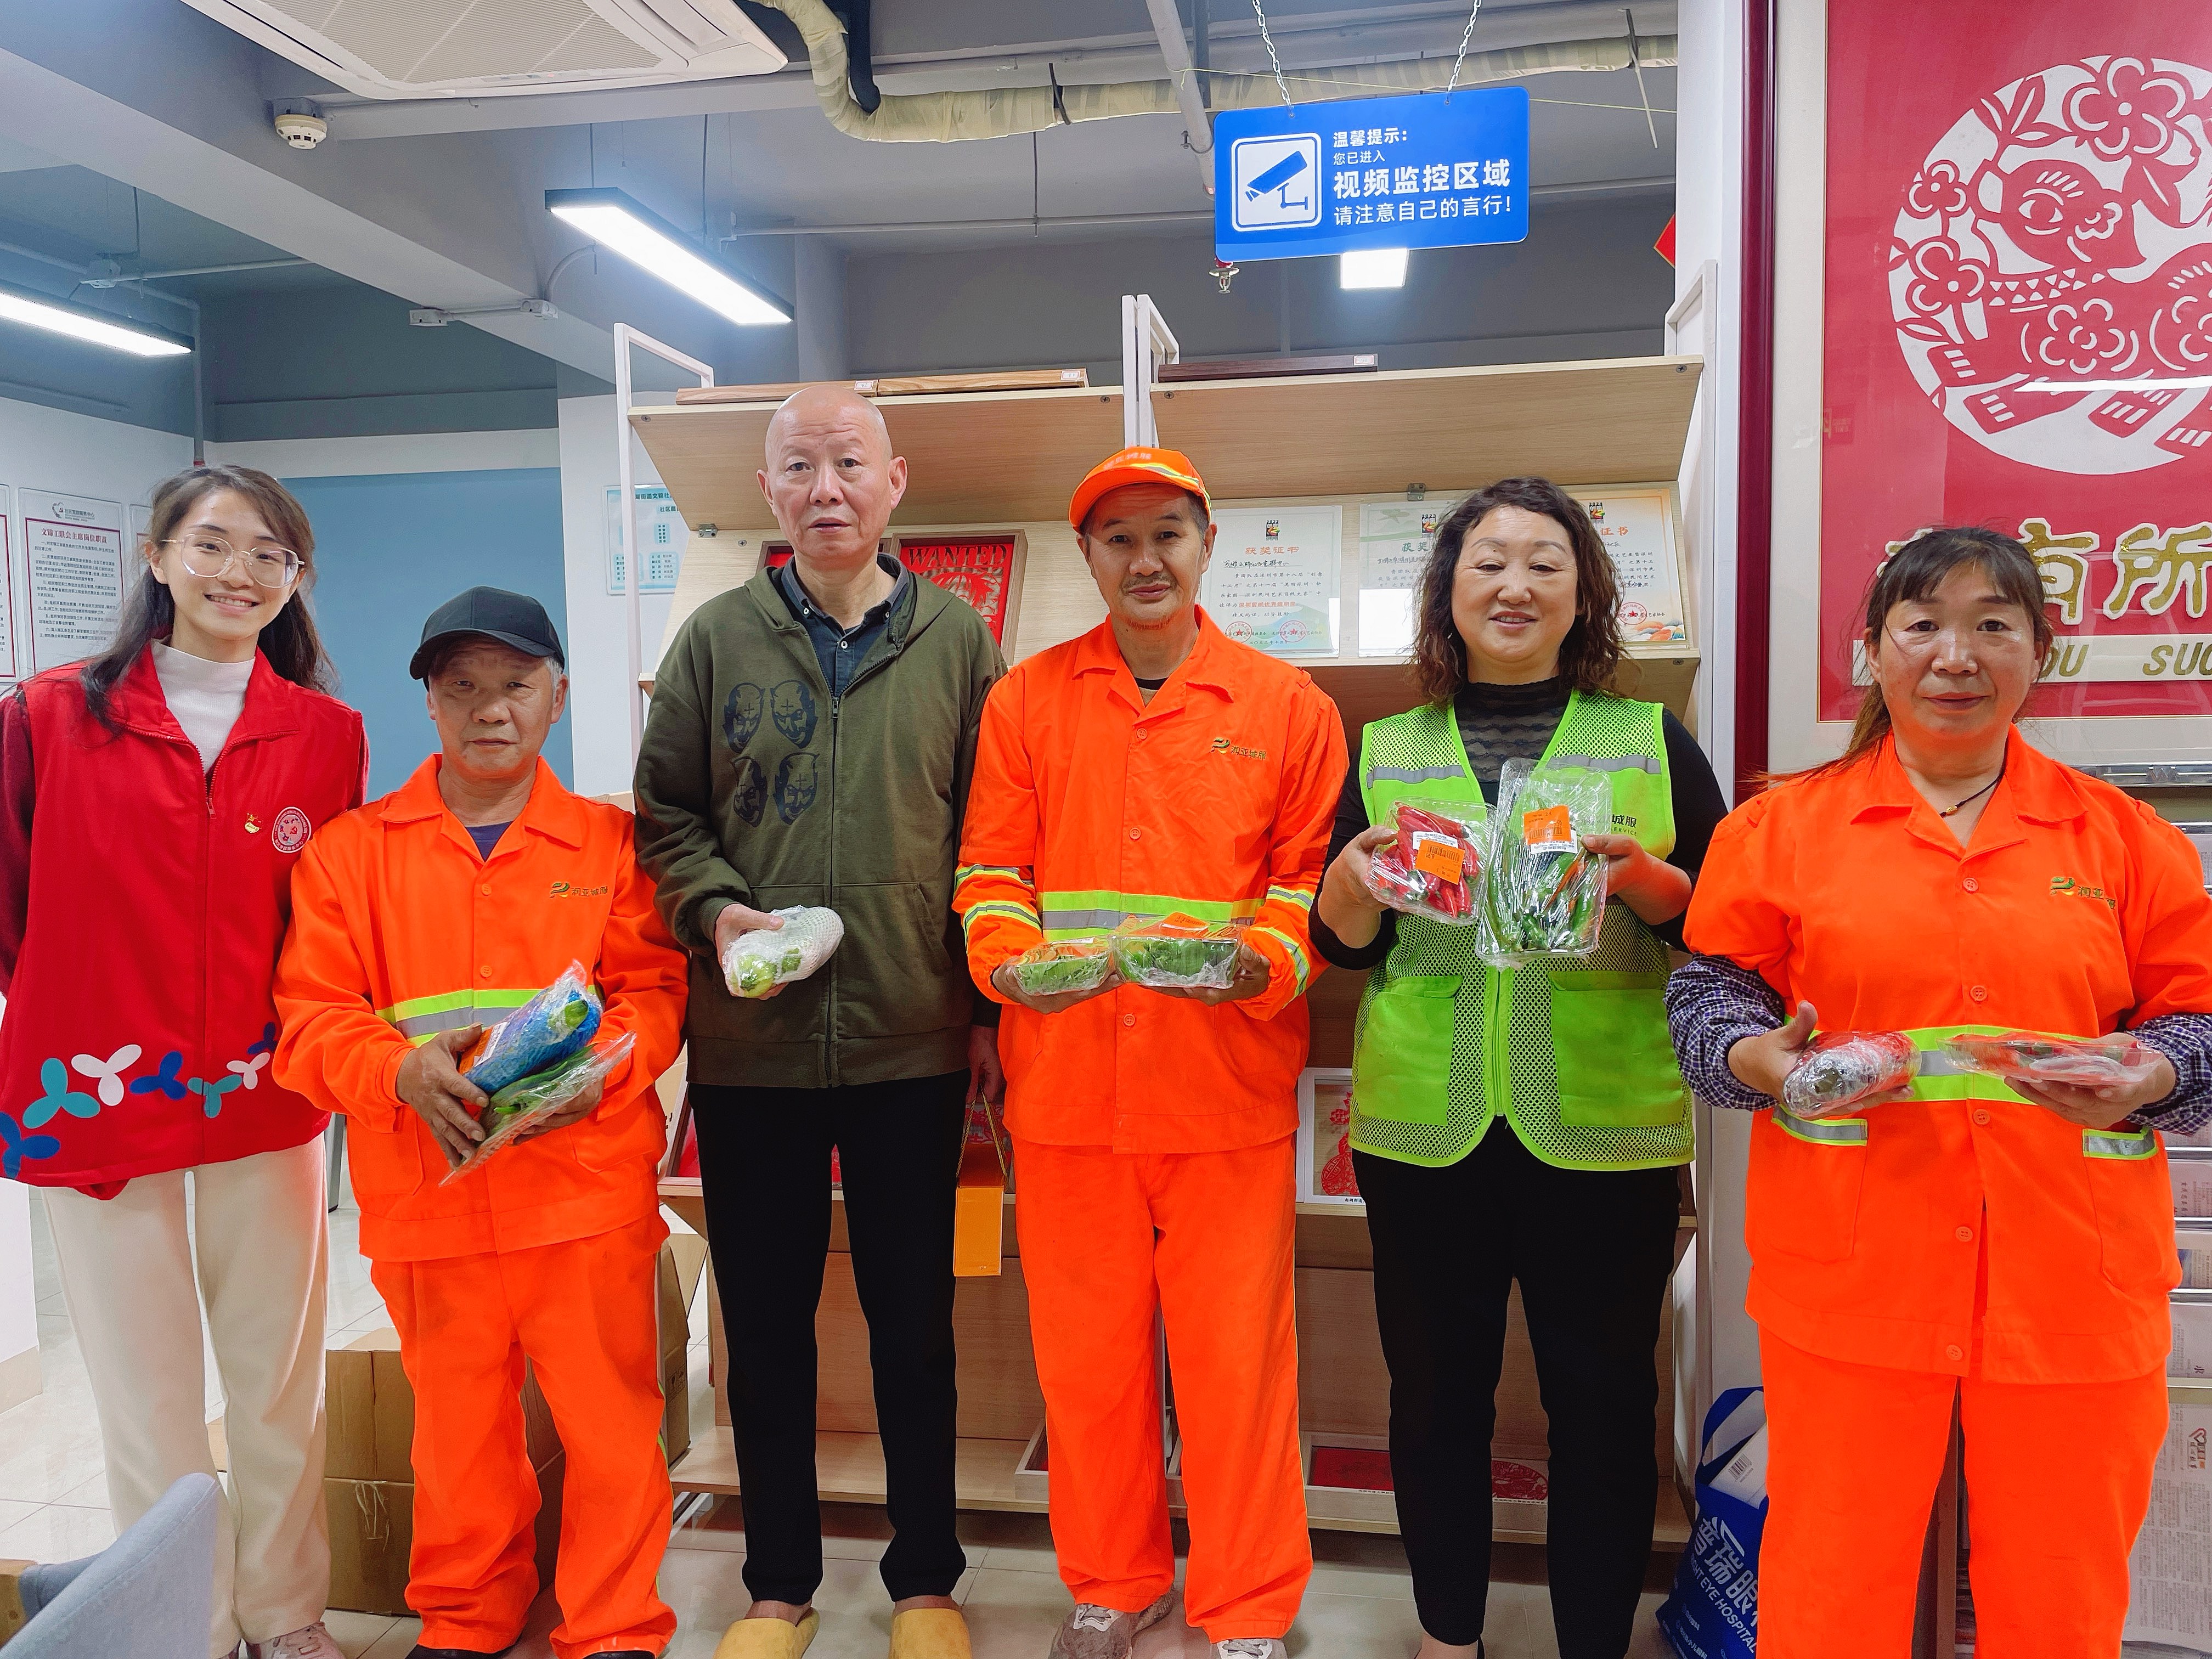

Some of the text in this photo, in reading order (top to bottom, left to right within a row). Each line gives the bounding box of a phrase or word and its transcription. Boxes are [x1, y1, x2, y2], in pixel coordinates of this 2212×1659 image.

[1333, 127, 1407, 148] 温馨提示:
[1333, 150, 1385, 166] 您已进入
[1333, 159, 1510, 199] 视频监控区域
[1334, 195, 1511, 226] 请注意自己的言行!
[1600, 526, 1628, 537] 证书
[909, 544, 1007, 567] WANTED
[1245, 546, 1300, 555] 获奖证书
[1612, 814, 1637, 828] 城服
[1694, 1517, 1758, 1627] 普瑞眼
[1700, 1576, 1720, 1601] EYE
[1714, 1598, 1758, 1654] HOSPITAL
